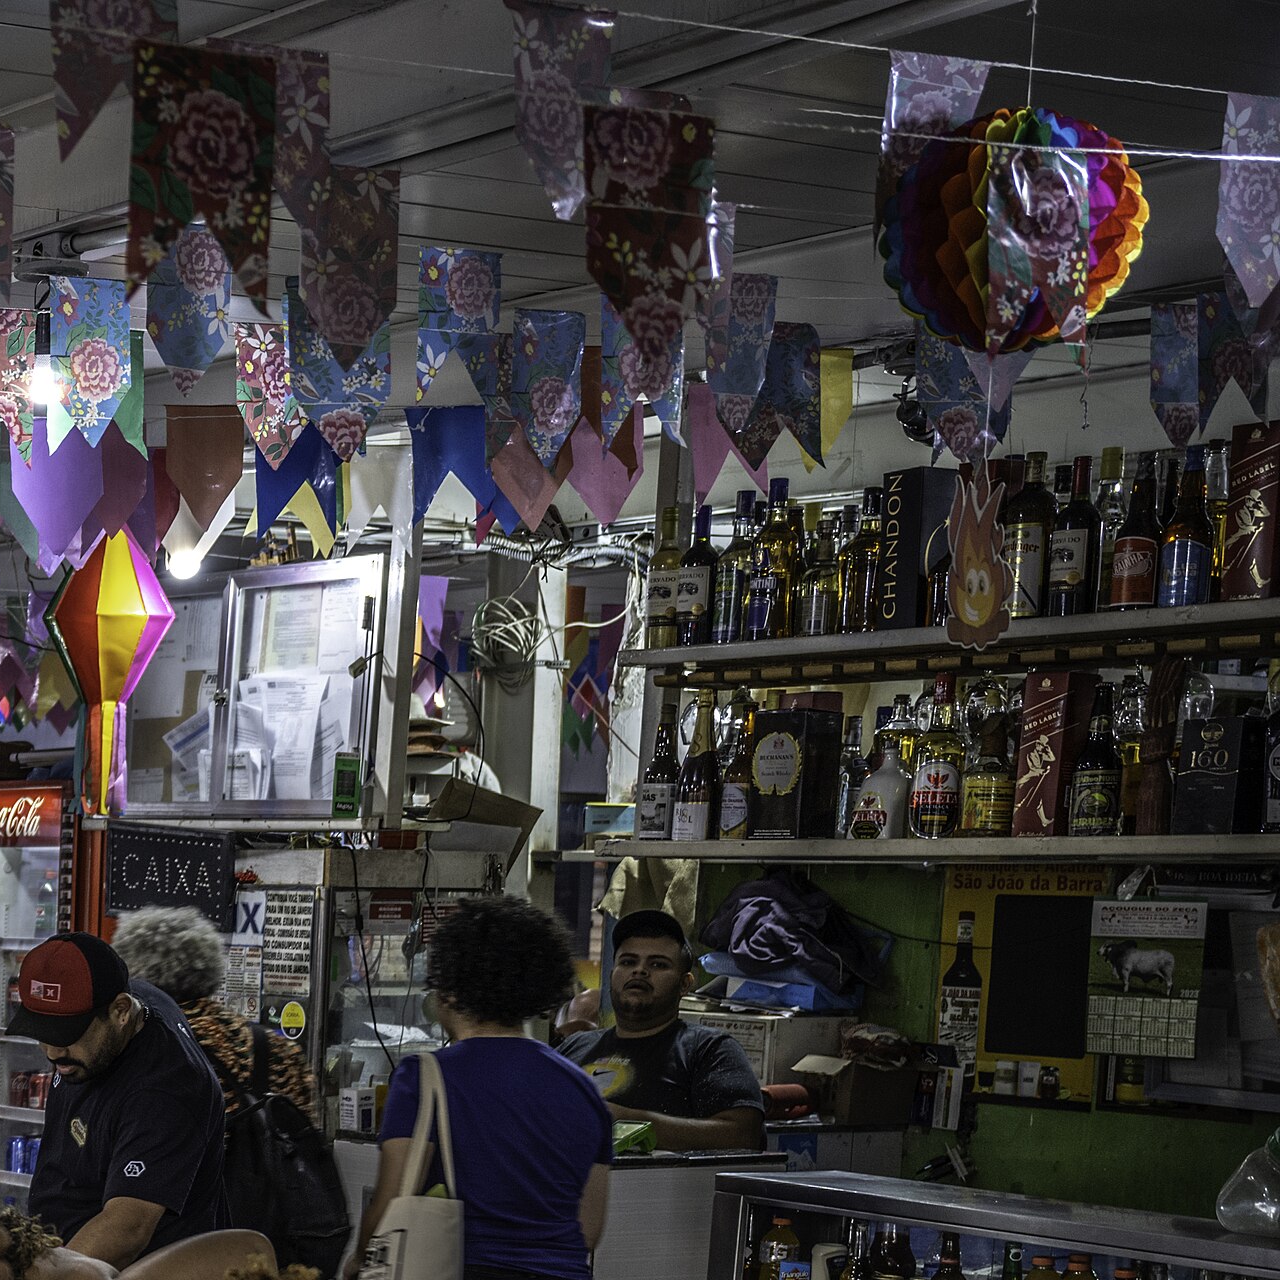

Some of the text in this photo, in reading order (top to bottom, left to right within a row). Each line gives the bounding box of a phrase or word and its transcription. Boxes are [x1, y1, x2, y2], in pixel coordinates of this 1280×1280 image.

[1249, 461, 1276, 480] LABEL
[882, 473, 904, 620] CHANDON
[1024, 710, 1062, 731] RED LABEL
[1190, 748, 1229, 768] 160
[912, 791, 960, 805] SELETA
[122, 852, 212, 898] CAIXA
[953, 873, 1103, 892] São João da Barra
[239, 901, 260, 934] X
